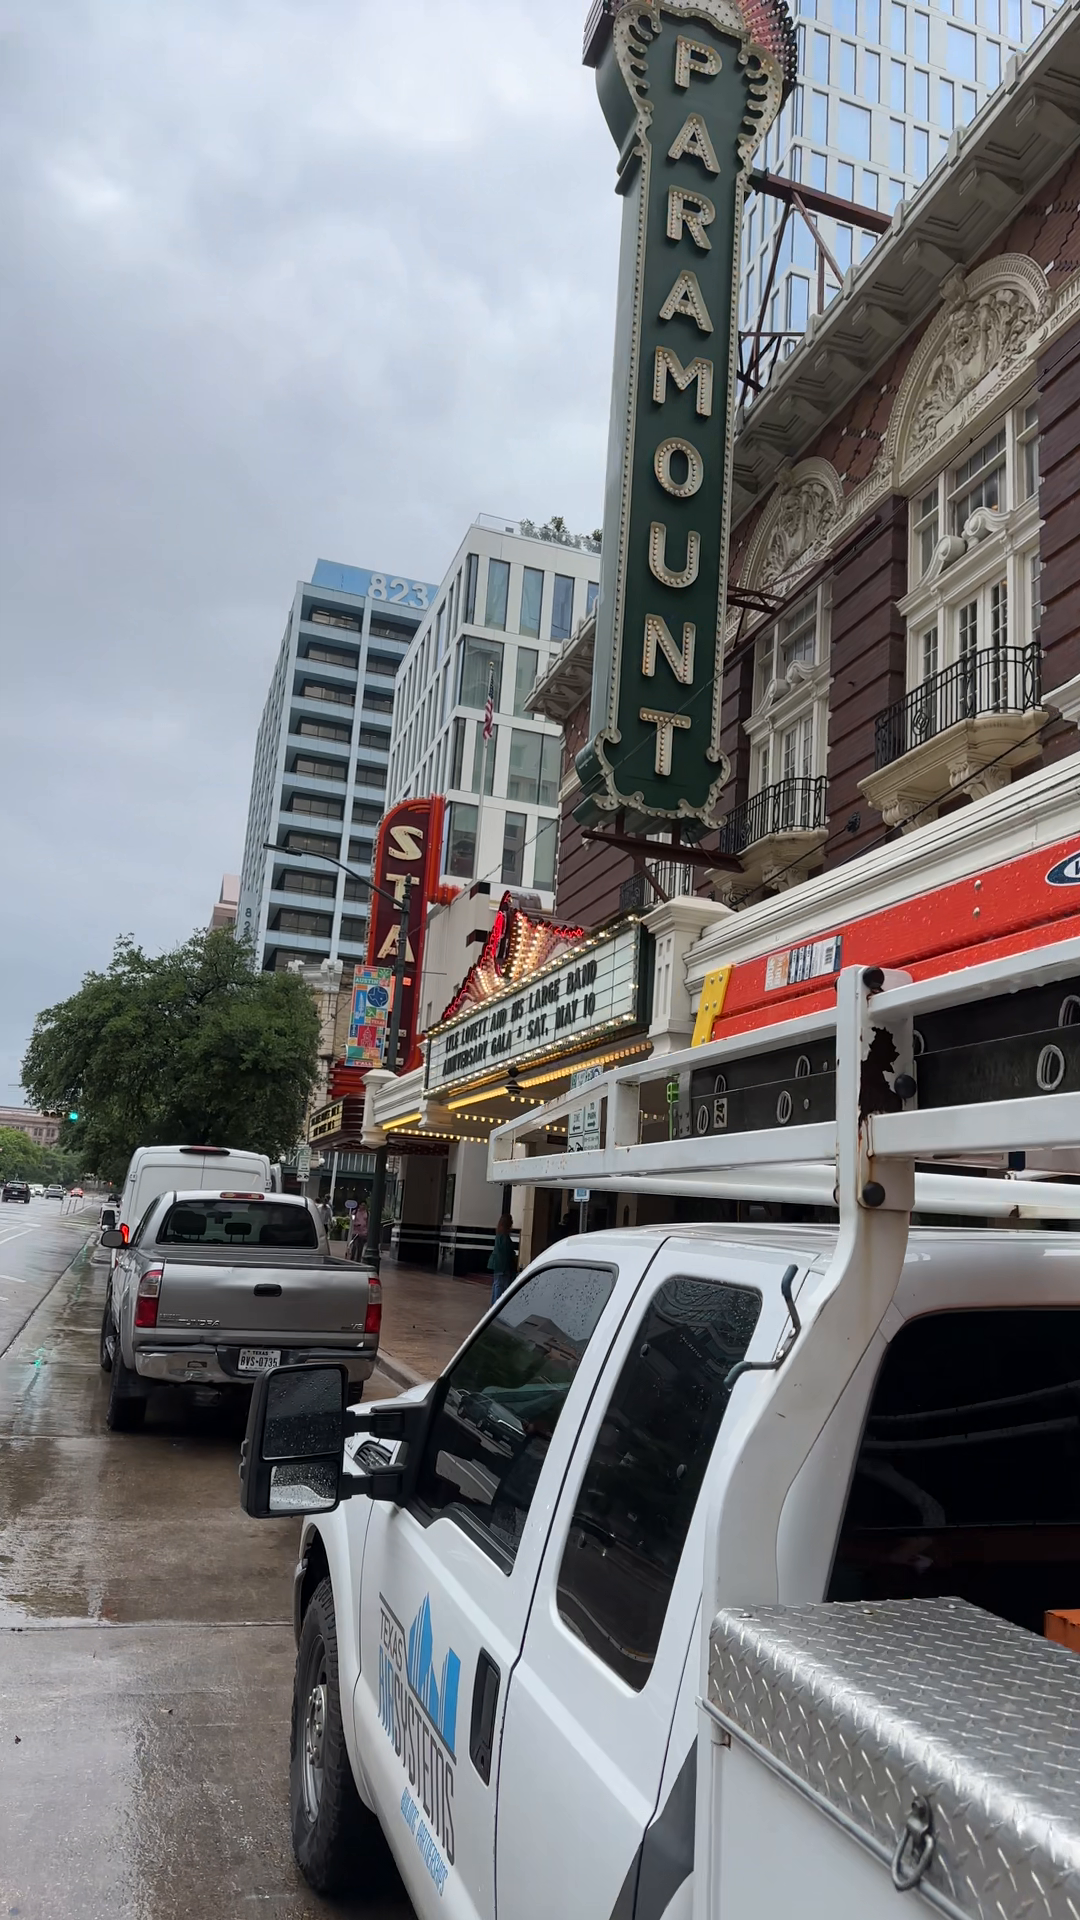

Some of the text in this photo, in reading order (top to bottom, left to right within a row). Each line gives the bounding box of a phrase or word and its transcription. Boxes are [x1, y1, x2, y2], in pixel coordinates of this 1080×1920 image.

[639, 34, 723, 776] PARAMOUNT
[367, 573, 429, 610] 823
[355, 977, 379, 985] AUSTIN
[461, 1016, 488, 1046] LOVETT
[489, 1008, 507, 1033] AND
[510, 998, 525, 1023] HIS
[528, 978, 560, 1013] LARGE
[566, 959, 597, 996] BAND
[442, 1040, 488, 1077] ANNIVERSARY
[491, 1030, 512, 1057] GALA
[555, 999, 578, 1030] MAY
[583, 992, 596, 1018] 10
[380, 1607, 403, 1672] TEXAS
